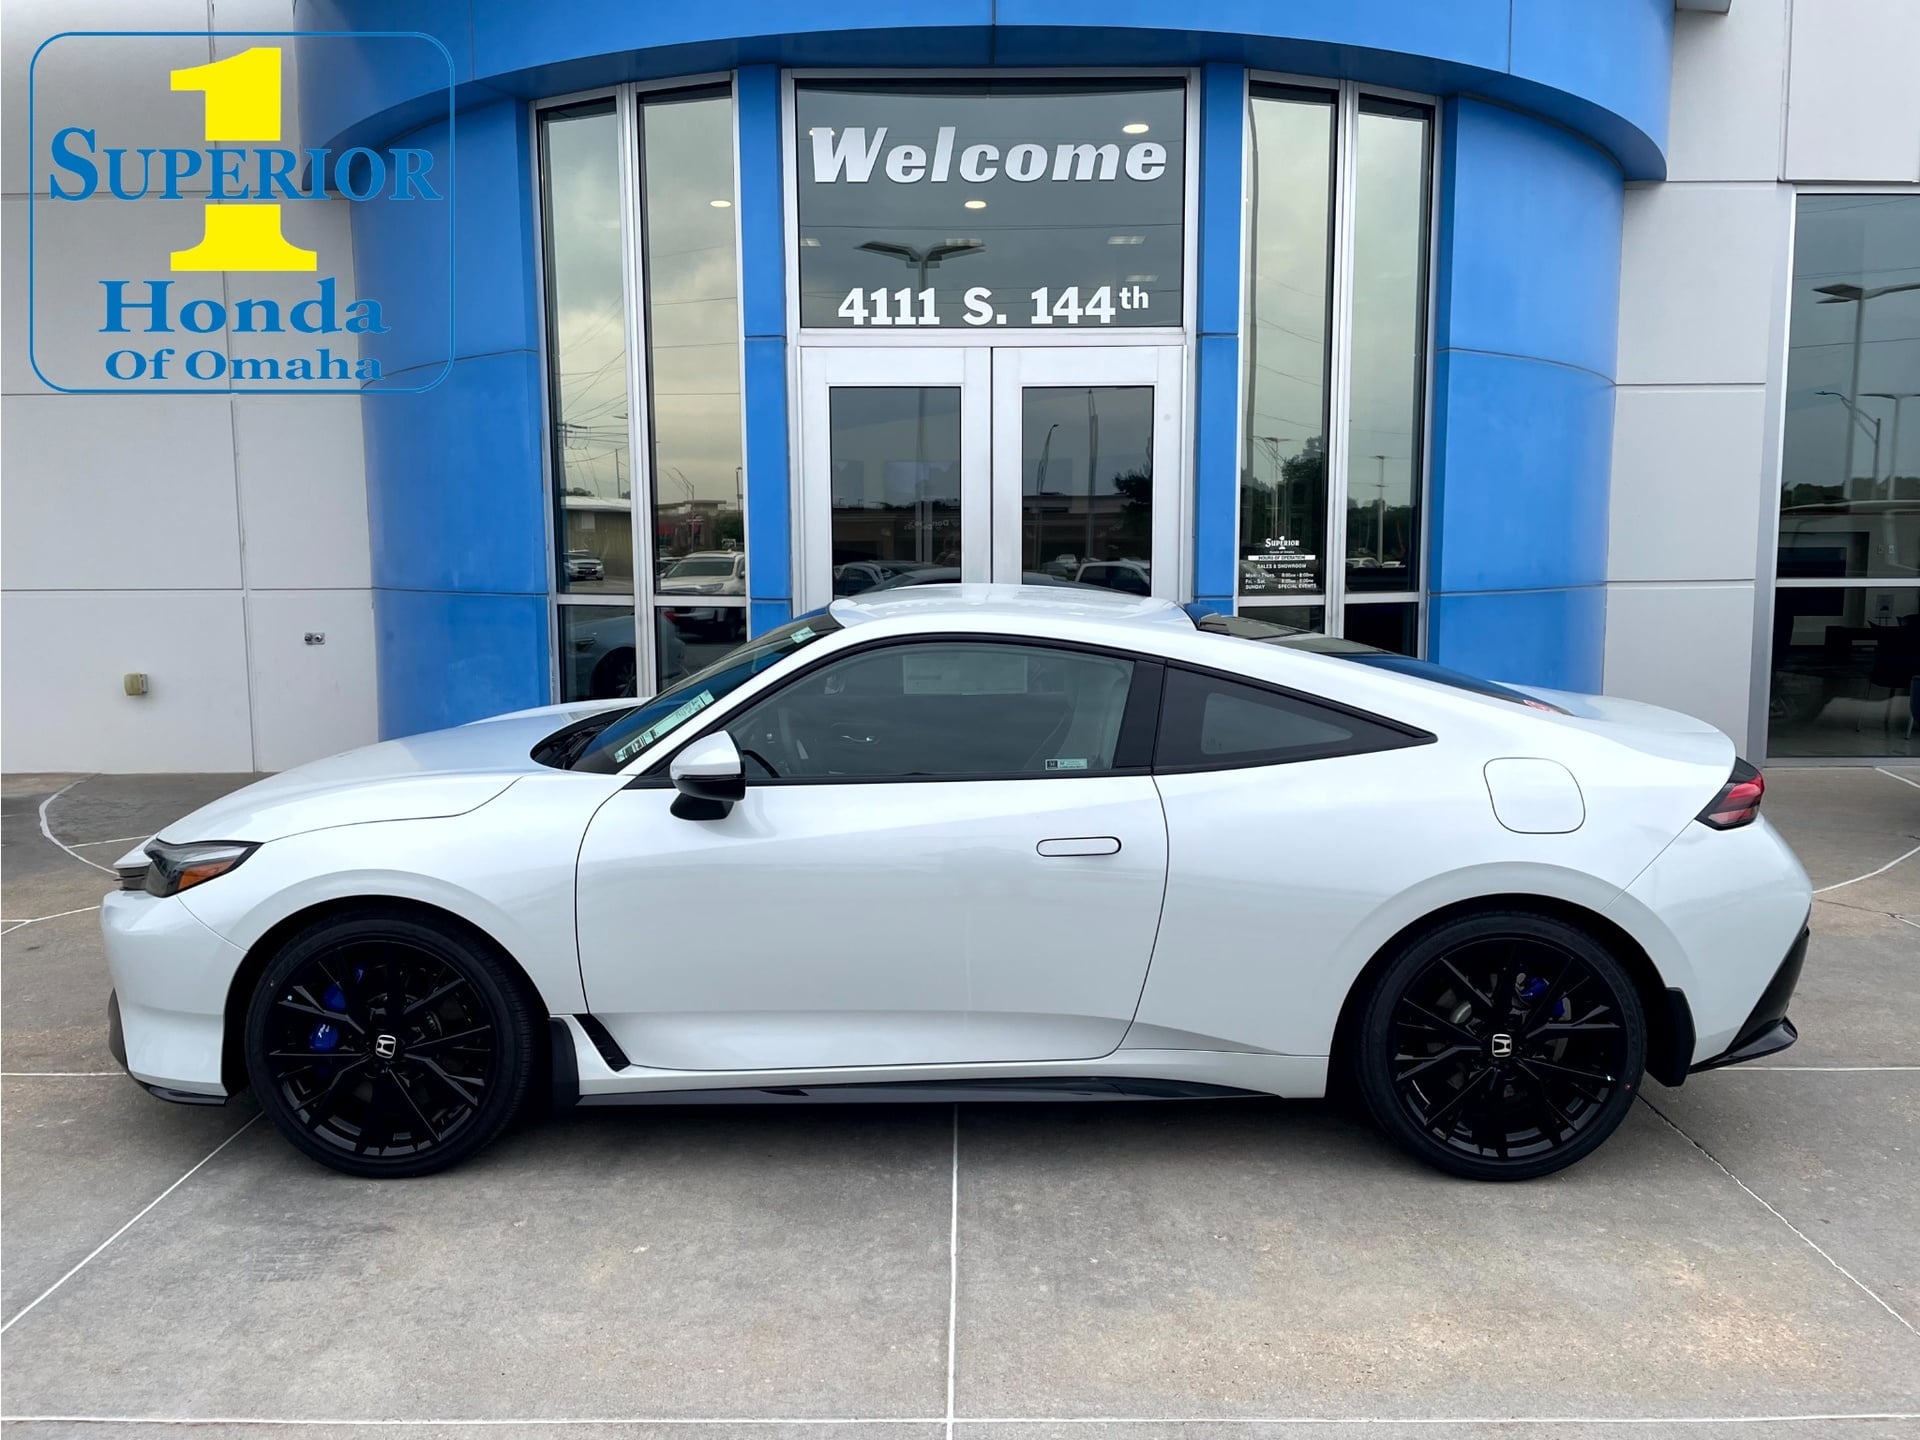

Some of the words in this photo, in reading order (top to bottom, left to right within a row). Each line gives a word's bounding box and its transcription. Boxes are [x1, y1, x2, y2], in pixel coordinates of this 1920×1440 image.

[810, 126, 1168, 183] Welcome
[838, 286, 940, 325] 4111
[962, 286, 1007, 325] S.
[1030, 285, 1149, 325] 144th
